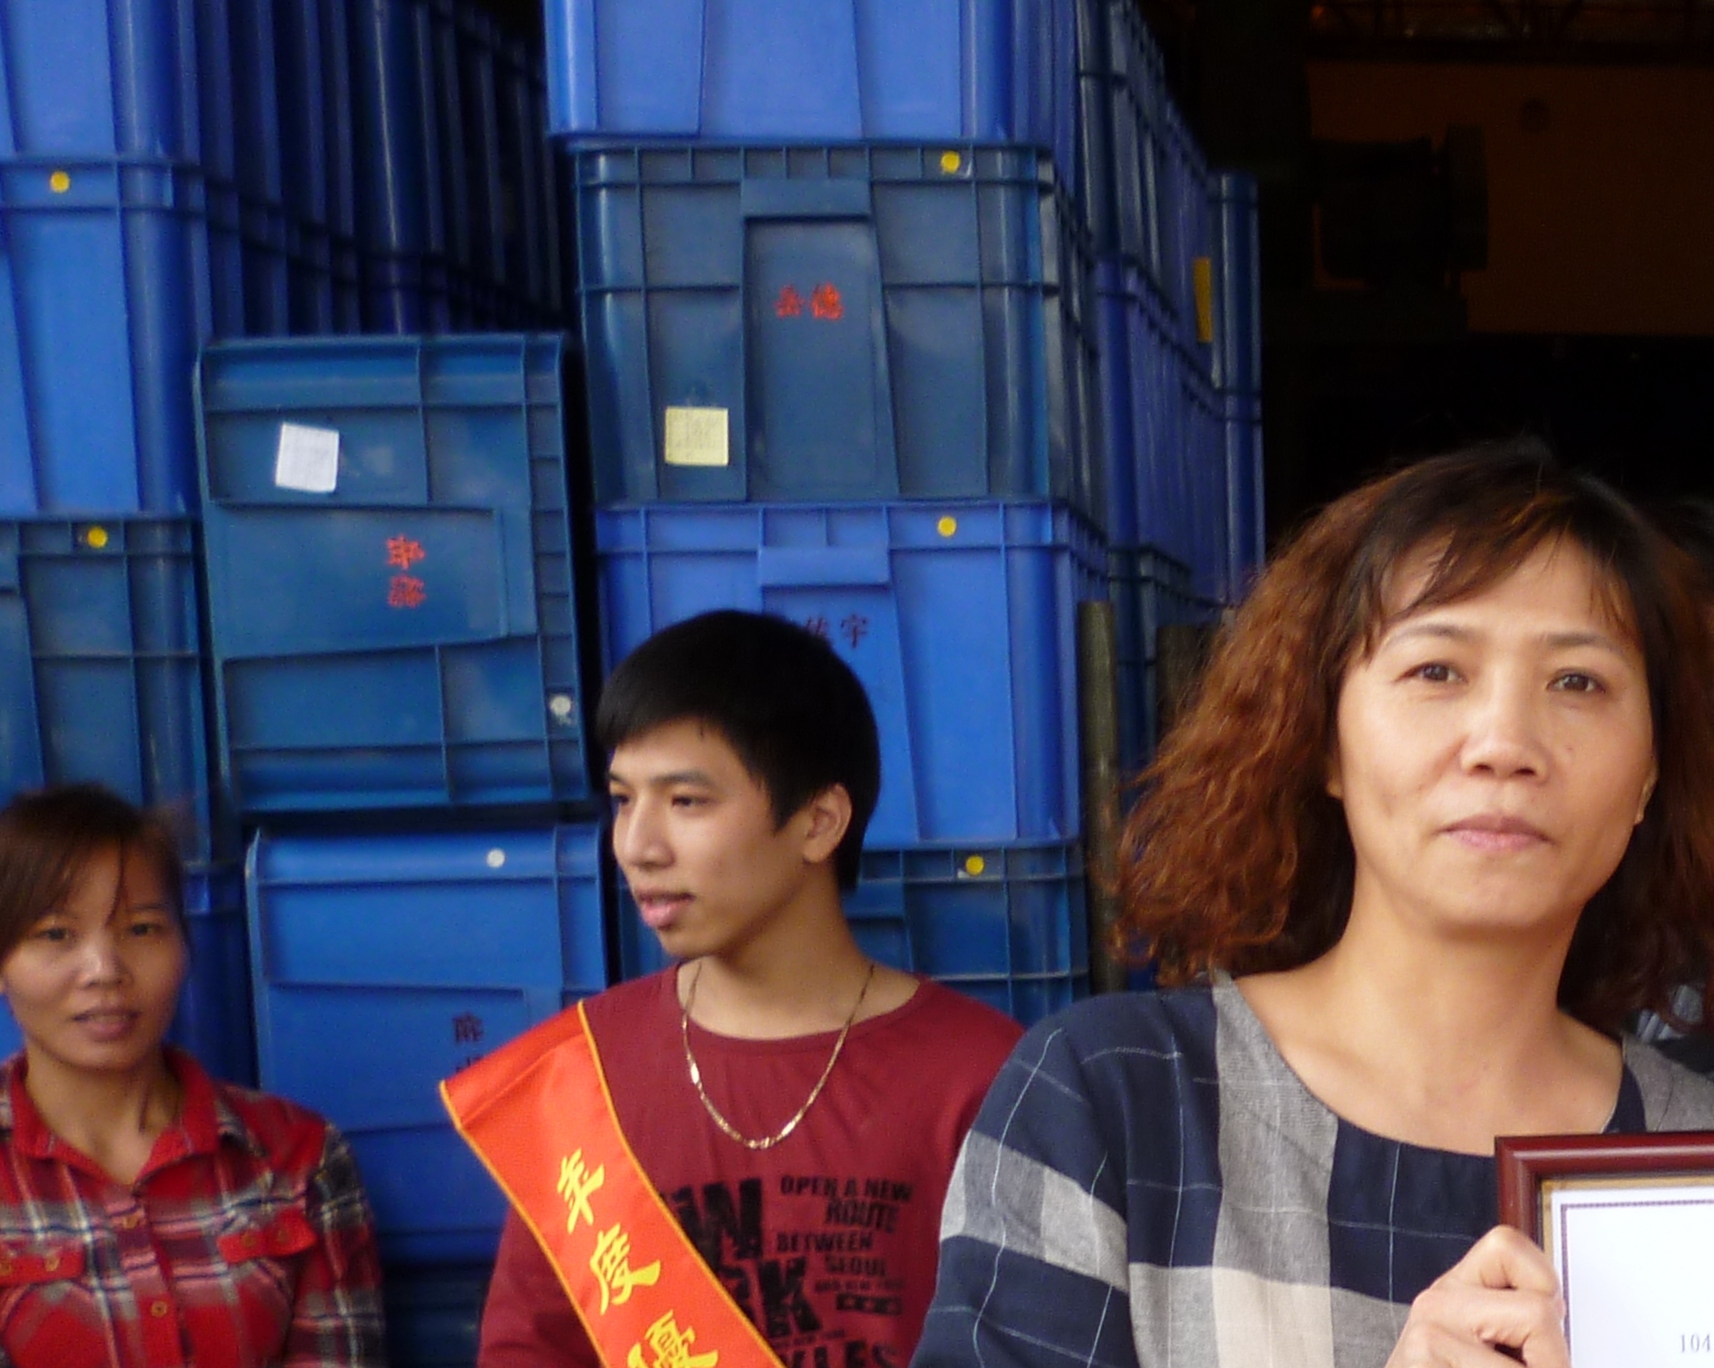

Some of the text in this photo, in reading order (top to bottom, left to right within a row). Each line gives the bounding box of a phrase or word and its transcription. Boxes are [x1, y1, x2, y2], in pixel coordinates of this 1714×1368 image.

[780, 1175, 914, 1202] OPEN A NEW
[825, 1201, 899, 1234] ROUTE
[777, 1231, 873, 1253] BETWEEN
